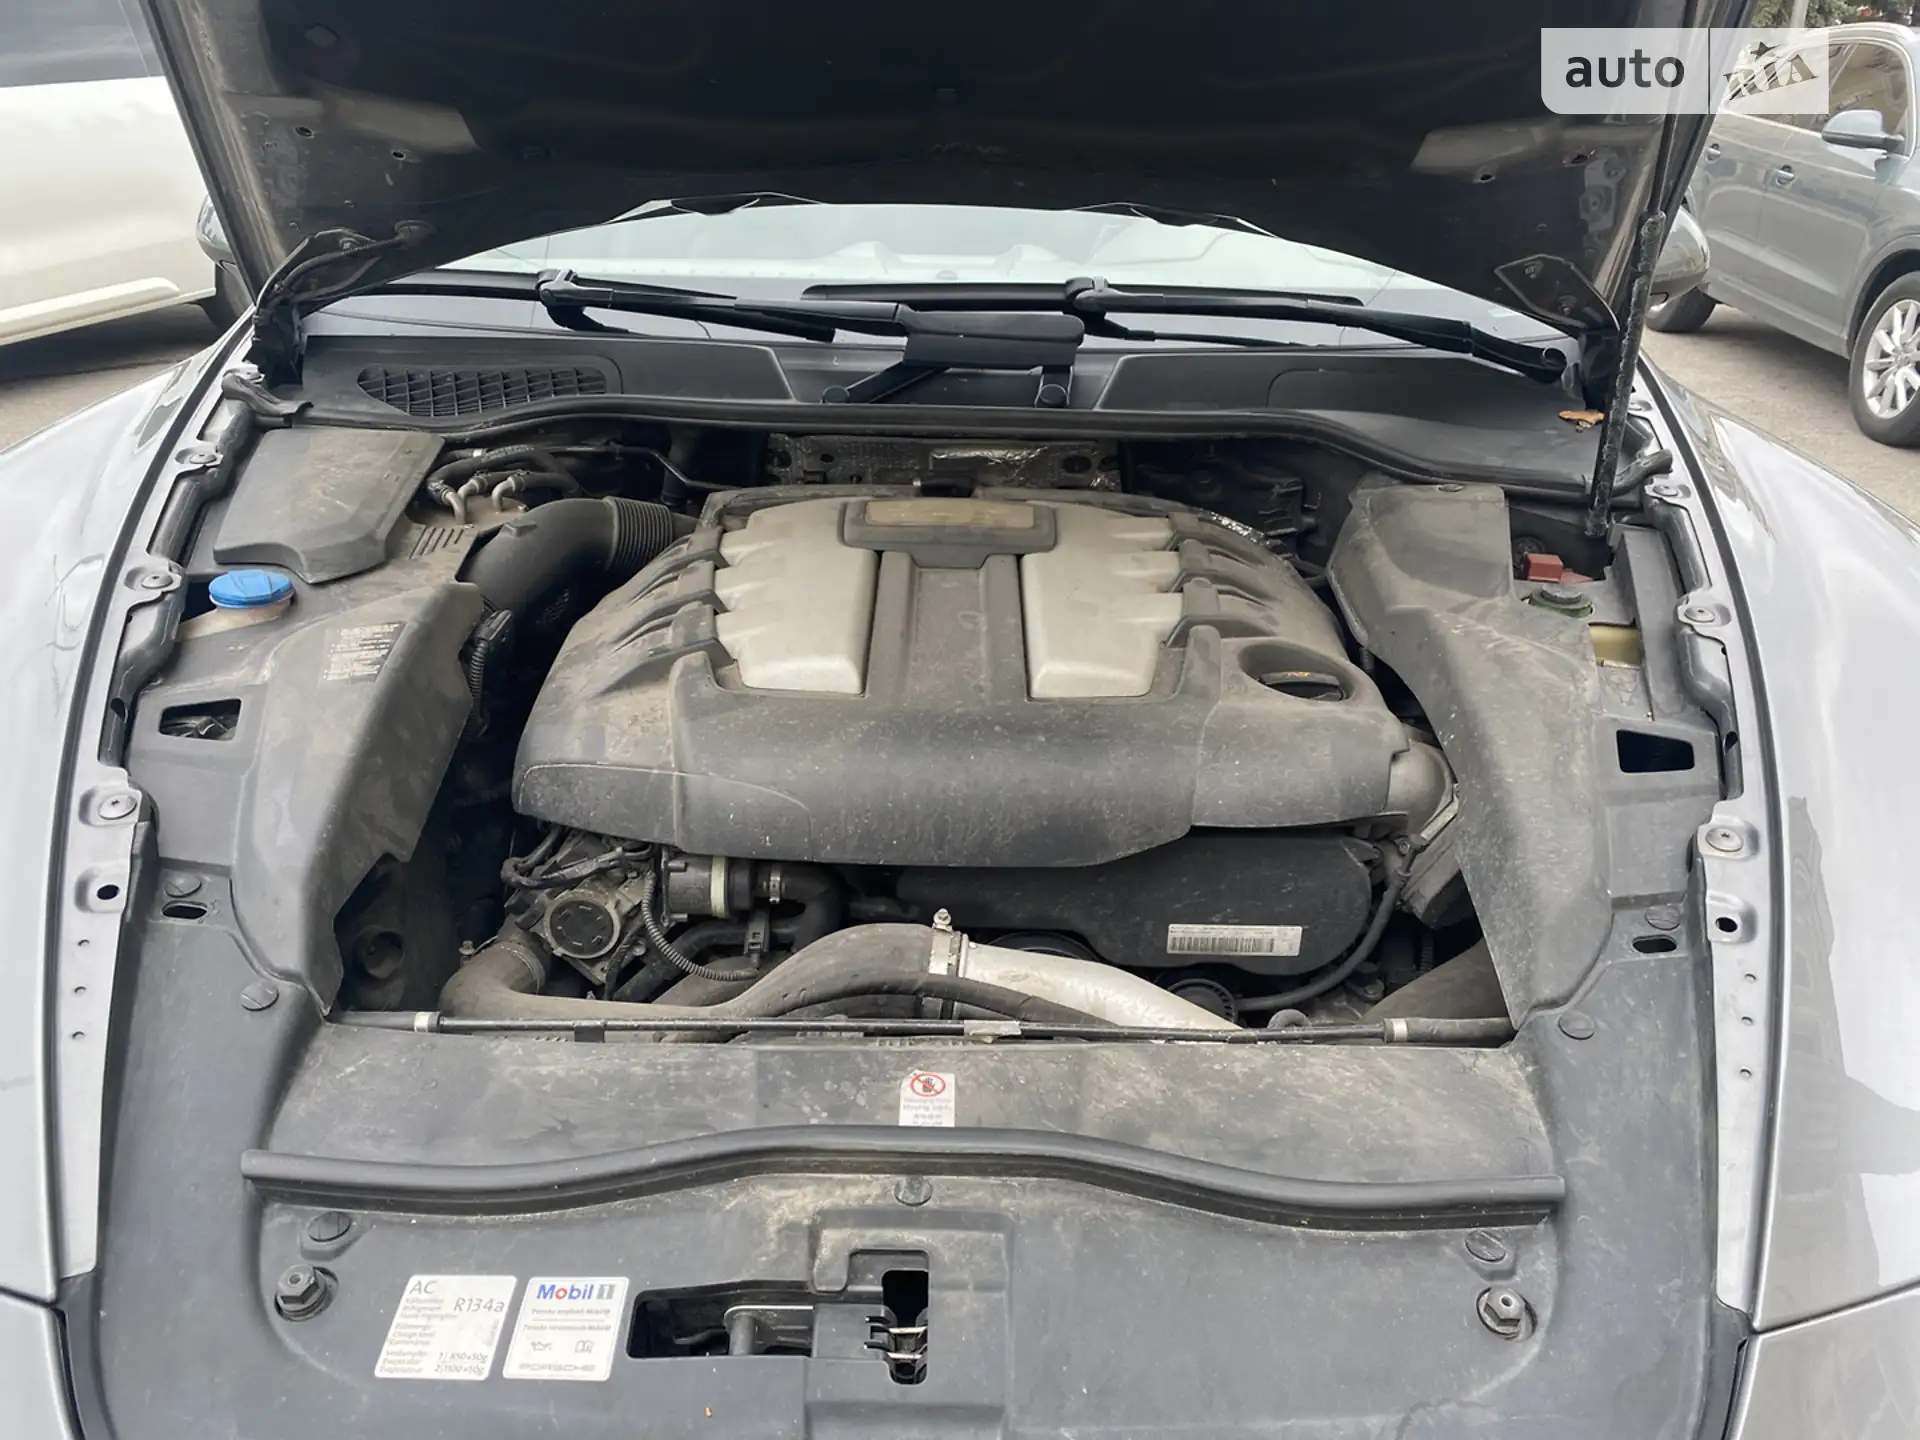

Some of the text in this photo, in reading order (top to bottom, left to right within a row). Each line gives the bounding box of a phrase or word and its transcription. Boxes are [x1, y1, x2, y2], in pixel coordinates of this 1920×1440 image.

[408, 1280, 437, 1294] AC
[536, 1283, 594, 1300] Mobil
[453, 1297, 505, 1313] R134a
